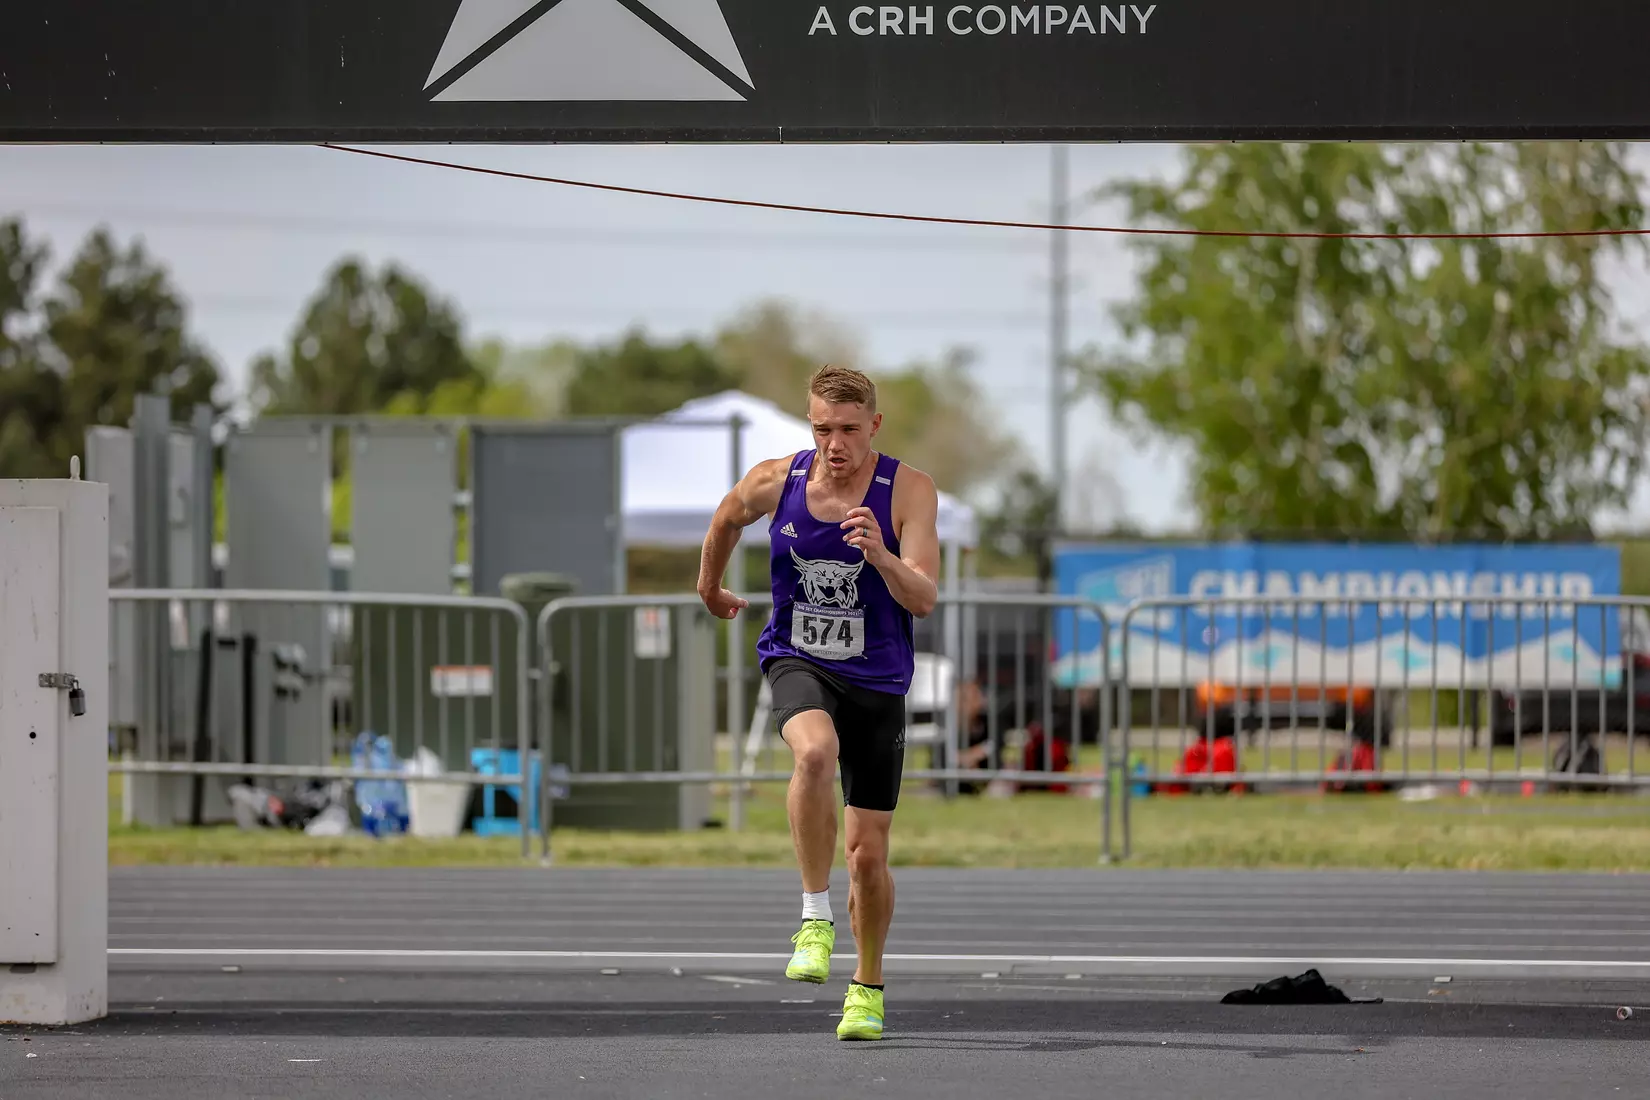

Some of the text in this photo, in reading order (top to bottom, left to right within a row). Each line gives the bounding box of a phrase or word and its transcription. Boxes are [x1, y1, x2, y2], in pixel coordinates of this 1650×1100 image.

[808, 4, 1157, 36] A CRH COMPANY
[780, 528, 798, 538] adidas
[803, 615, 853, 648] 574
